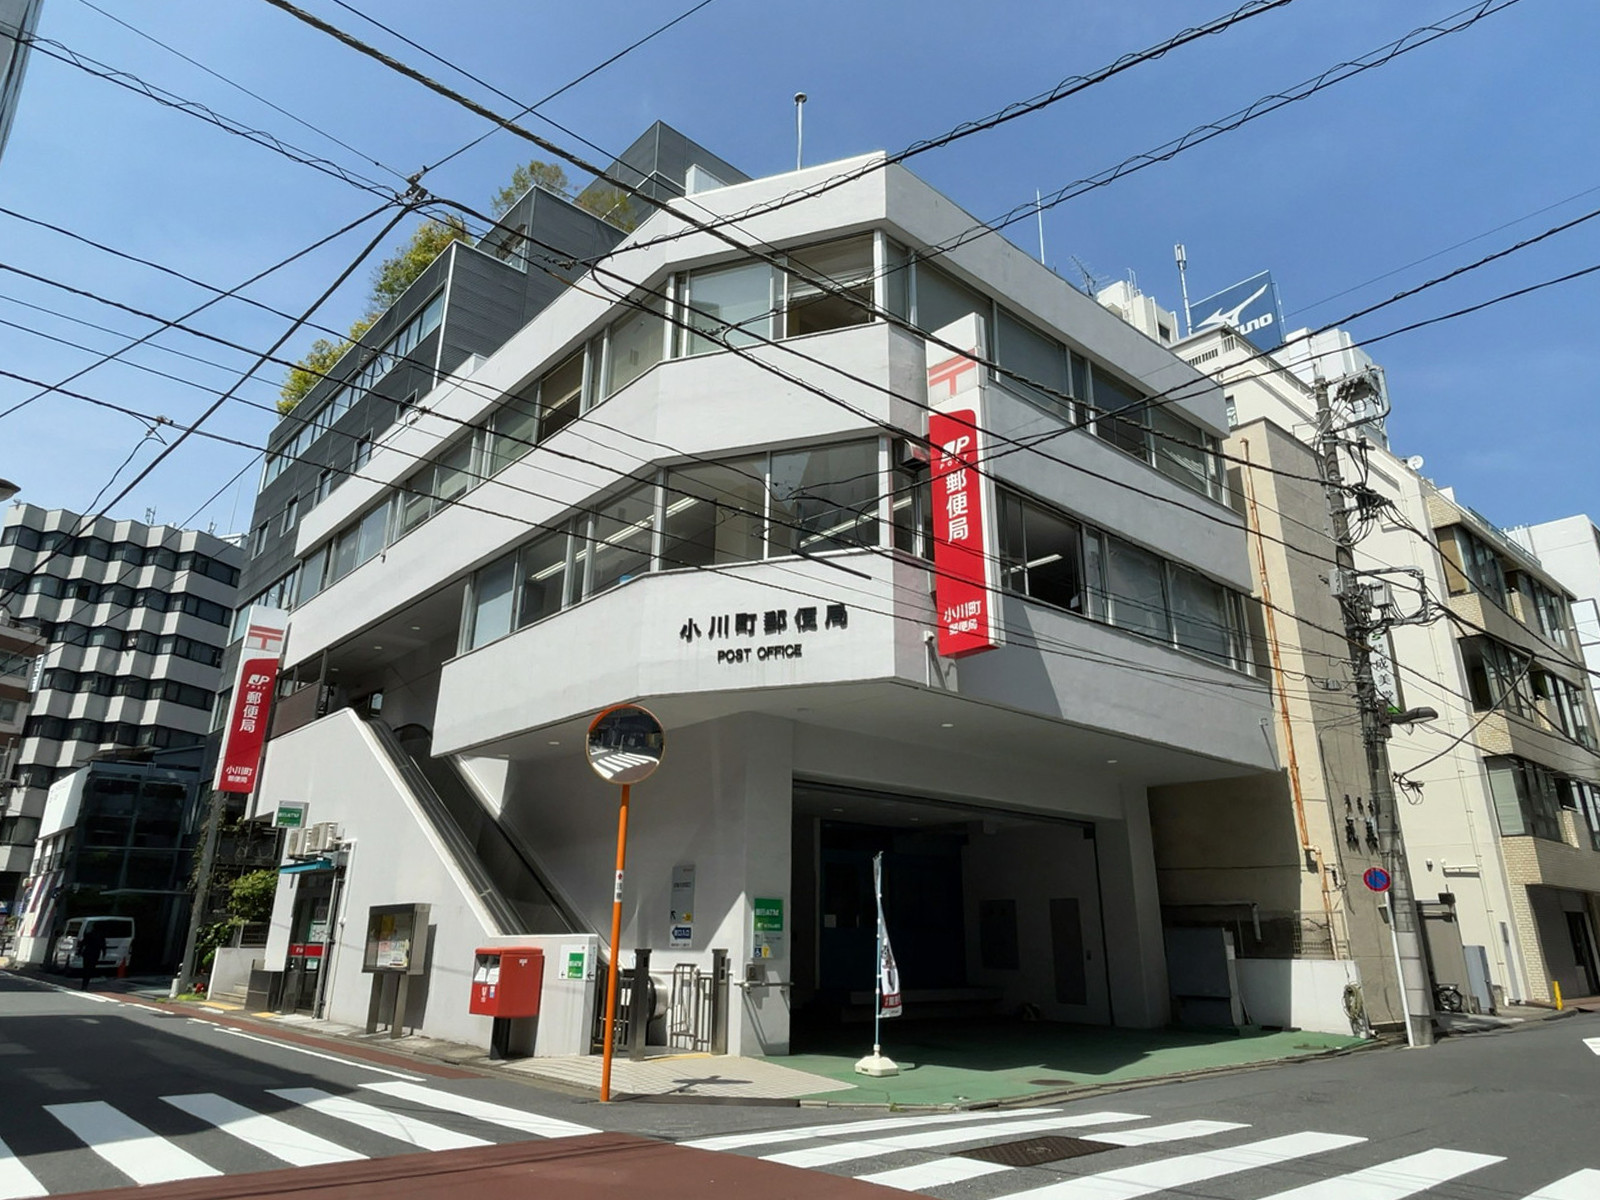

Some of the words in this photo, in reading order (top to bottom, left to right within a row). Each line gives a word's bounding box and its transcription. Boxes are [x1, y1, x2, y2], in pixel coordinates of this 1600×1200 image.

[946, 468, 969, 544] 郵便局
[679, 602, 848, 643] 小川町郵便局
[943, 600, 982, 623] 小川町
[717, 648, 752, 664] POST
[757, 643, 803, 661] OFFICE
[239, 691, 263, 734] 郵便局
[225, 765, 253, 776] 小川町
